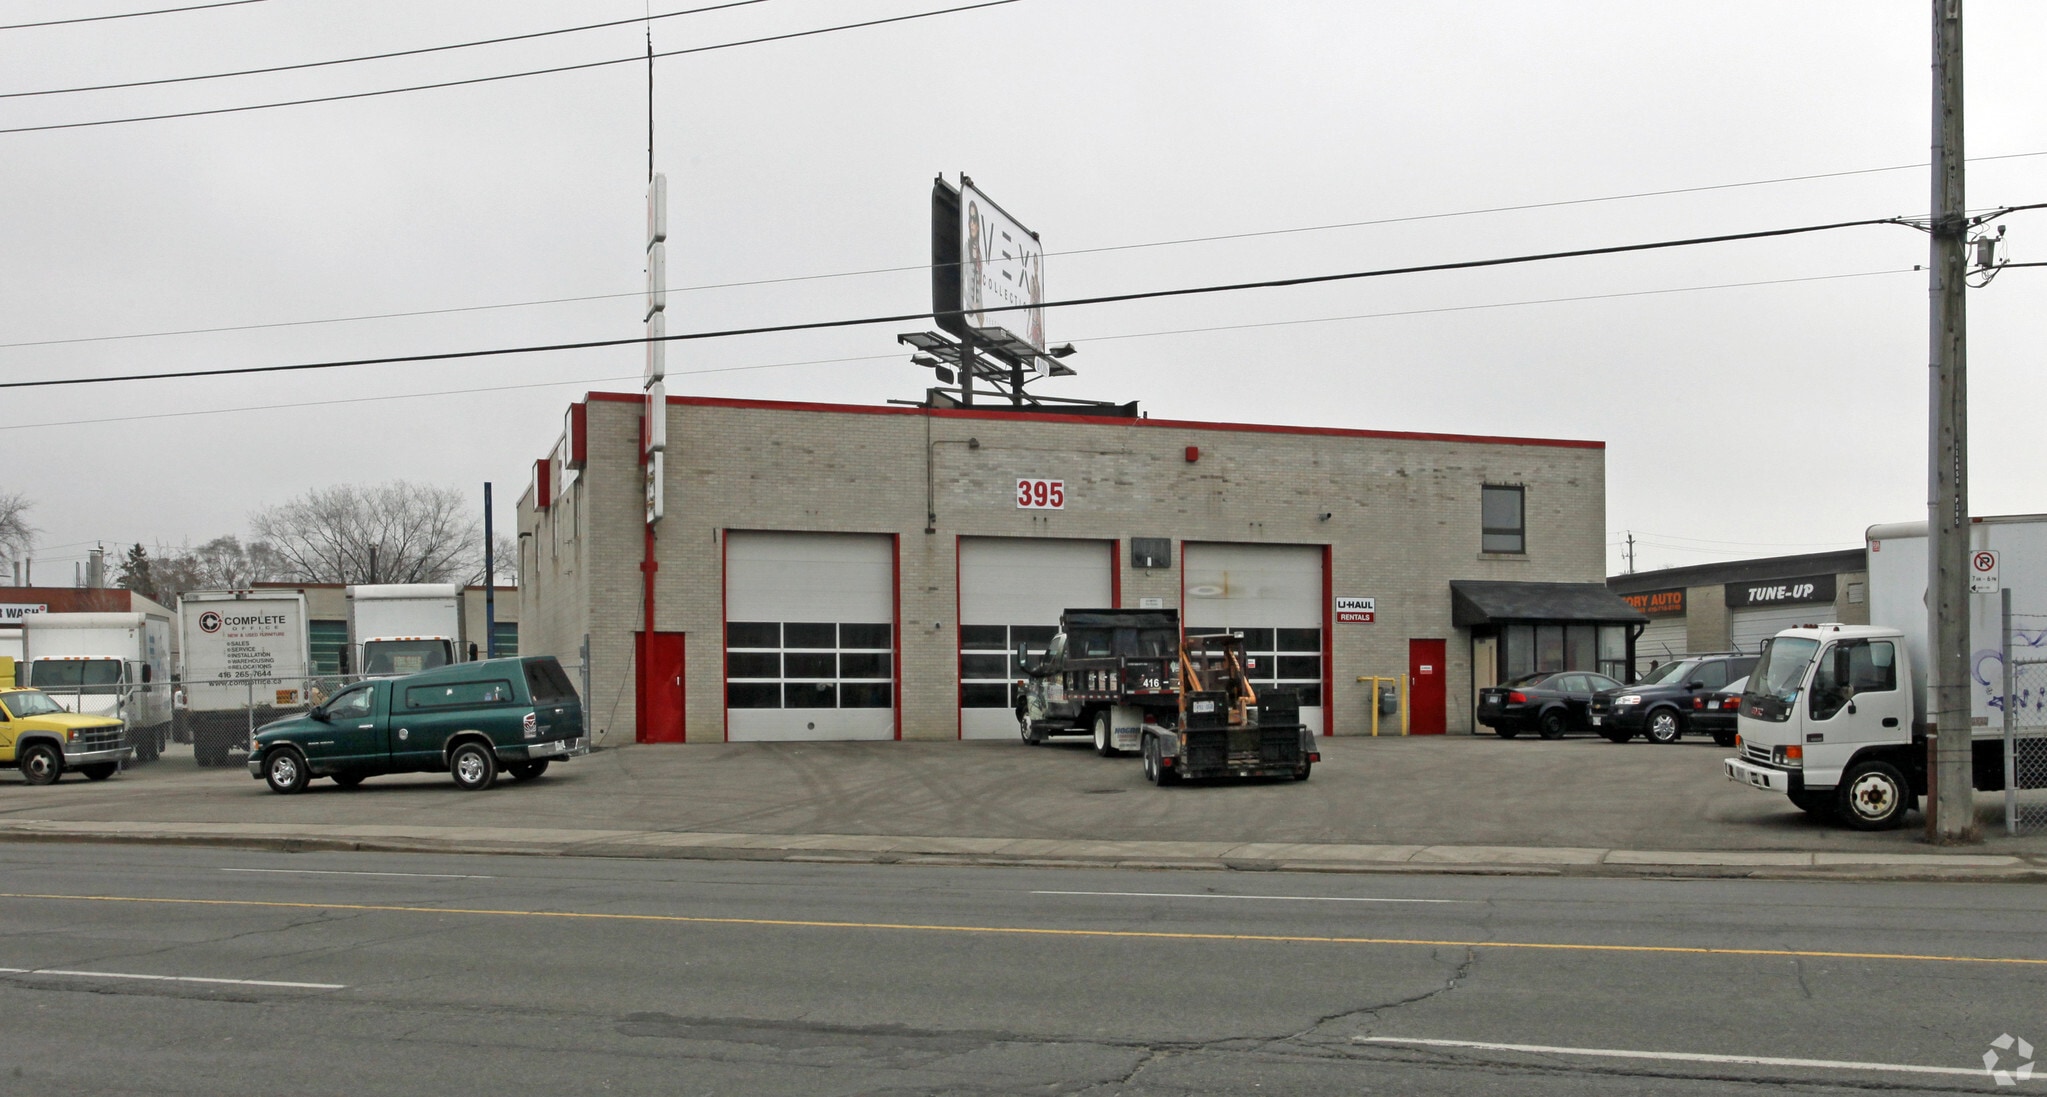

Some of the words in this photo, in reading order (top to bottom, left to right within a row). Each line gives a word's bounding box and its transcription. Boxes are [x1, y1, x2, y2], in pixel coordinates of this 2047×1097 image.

[981, 214, 1030, 295] VEX
[983, 274, 1028, 313] COLLECTIO
[1018, 480, 1064, 507] 395
[1651, 591, 1682, 606] AUTO
[1748, 583, 1814, 602] TUNE-UP
[1337, 600, 1374, 609] U-HAUL
[224, 615, 286, 626] COMPLETE
[1340, 613, 1370, 621] RENTALS
[1142, 678, 1160, 688] 416
